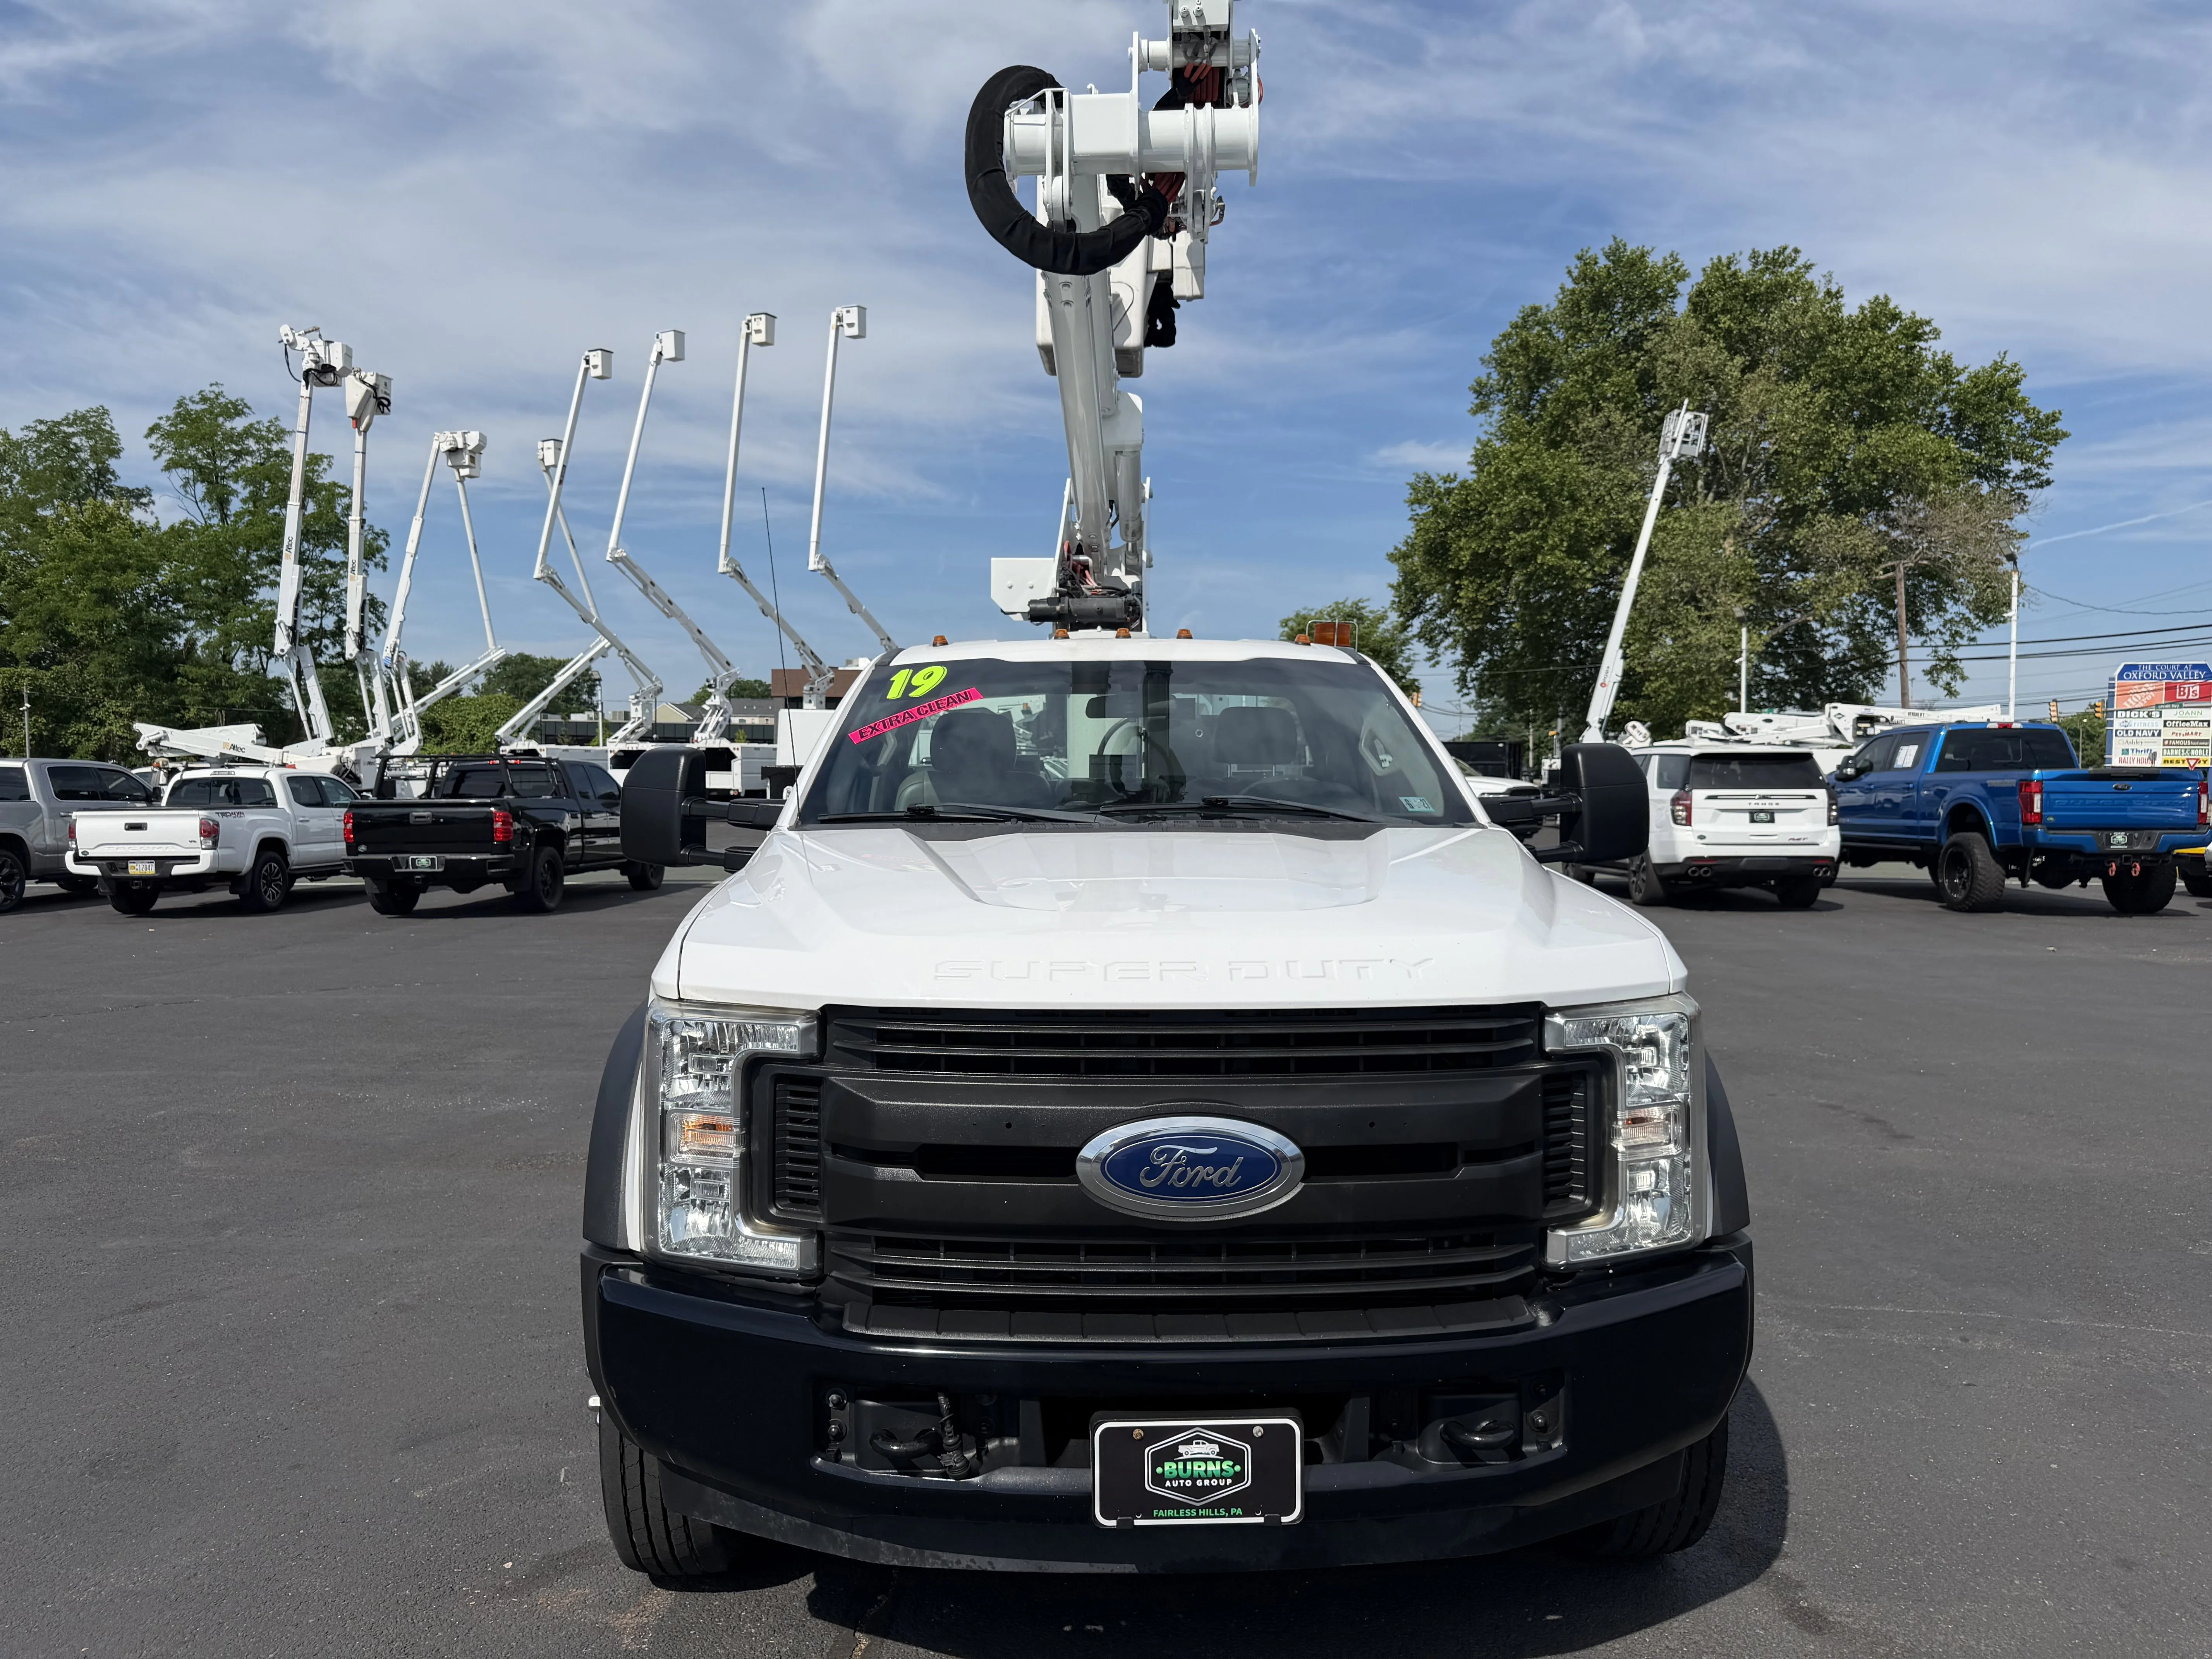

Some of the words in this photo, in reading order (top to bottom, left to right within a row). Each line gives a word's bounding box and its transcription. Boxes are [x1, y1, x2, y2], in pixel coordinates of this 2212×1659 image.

[886, 666, 948, 700] 19
[2124, 671, 2167, 680] OXFORD
[2170, 671, 2206, 680] VALLEY
[859, 711, 915, 738] EXTRA
[917, 692, 971, 716] CLEAN
[934, 960, 1210, 982] SUPER
[1228, 958, 1434, 981] DUTY
[1140, 1144, 1243, 1188] Ford
[1164, 1460, 1234, 1479] BURNS
[1165, 1479, 1192, 1487] AUTO
[1153, 1509, 1197, 1517] FAIRLESS
[1199, 1508, 1229, 1517] HILLS,
